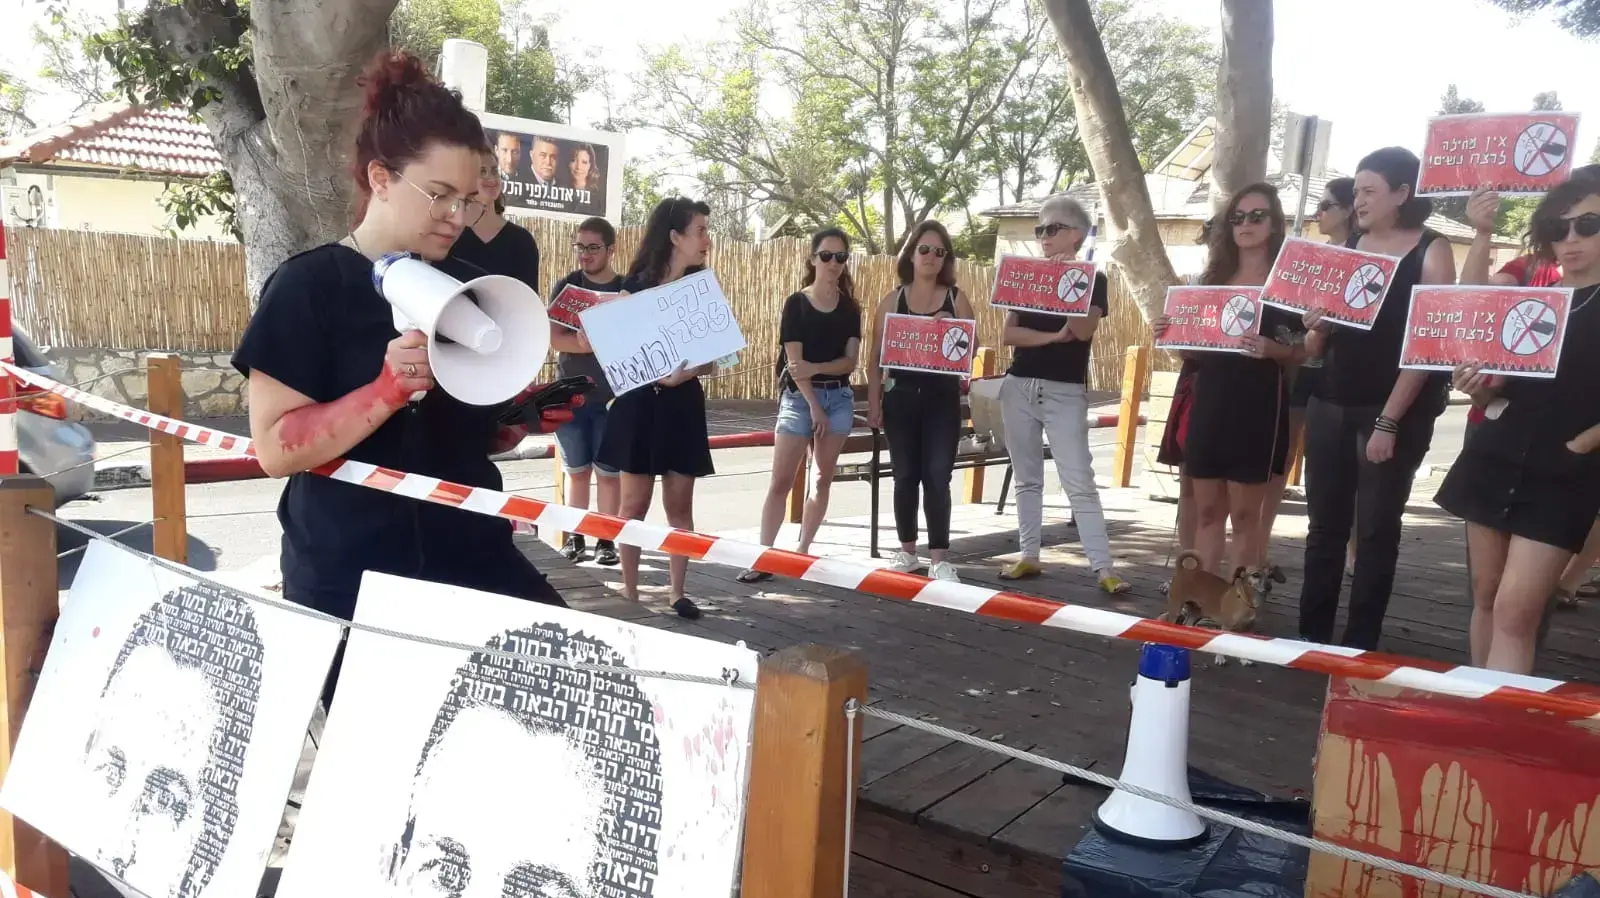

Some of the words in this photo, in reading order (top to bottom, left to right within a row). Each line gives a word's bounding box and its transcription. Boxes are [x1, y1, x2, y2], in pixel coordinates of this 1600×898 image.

[1442, 137, 1477, 152] מחילה
[1486, 136, 1508, 150] אין
[1470, 151, 1507, 165] לרצח
[576, 189, 591, 204] בני
[1292, 259, 1322, 275] מחילה
[1326, 267, 1346, 281] אין
[1009, 271, 1035, 281] מחילה
[1040, 273, 1054, 283] אין
[1027, 282, 1053, 294] לרצח
[1311, 278, 1341, 295] לרצח
[1426, 311, 1463, 323] מחילה
[1473, 311, 1496, 327] אין
[896, 330, 920, 340] מחילה
[925, 332, 939, 344] אין
[1455, 327, 1495, 342] לרצח
[915, 342, 938, 353] לרצח
[208, 598, 246, 626] הבאה
[199, 627, 228, 646] בתור?
[534, 626, 554, 639] תהיה
[556, 631, 564, 641] מי
[170, 632, 208, 658] הבאה
[228, 638, 258, 659] הבאה
[208, 645, 244, 672] תהיה
[480, 666, 508, 682] הבאה
[517, 659, 551, 678] הבאה
[555, 666, 587, 686] תהיה
[510, 672, 535, 687] תהיה
[450, 675, 507, 706] בתור?
[512, 689, 568, 721] הבאה
[600, 693, 643, 719] הבאה
[574, 704, 626, 738] תהיה
[633, 720, 655, 745] מי
[604, 734, 641, 756] הבאה
[598, 748, 625, 764] הבאה
[627, 756, 651, 772] תהיה
[622, 766, 663, 792] תהיה
[630, 787, 657, 804] הבאה
[632, 801, 661, 824] היה
[622, 820, 661, 851] היה
[635, 856, 657, 872] תהיה
[596, 861, 659, 893] הבאה
